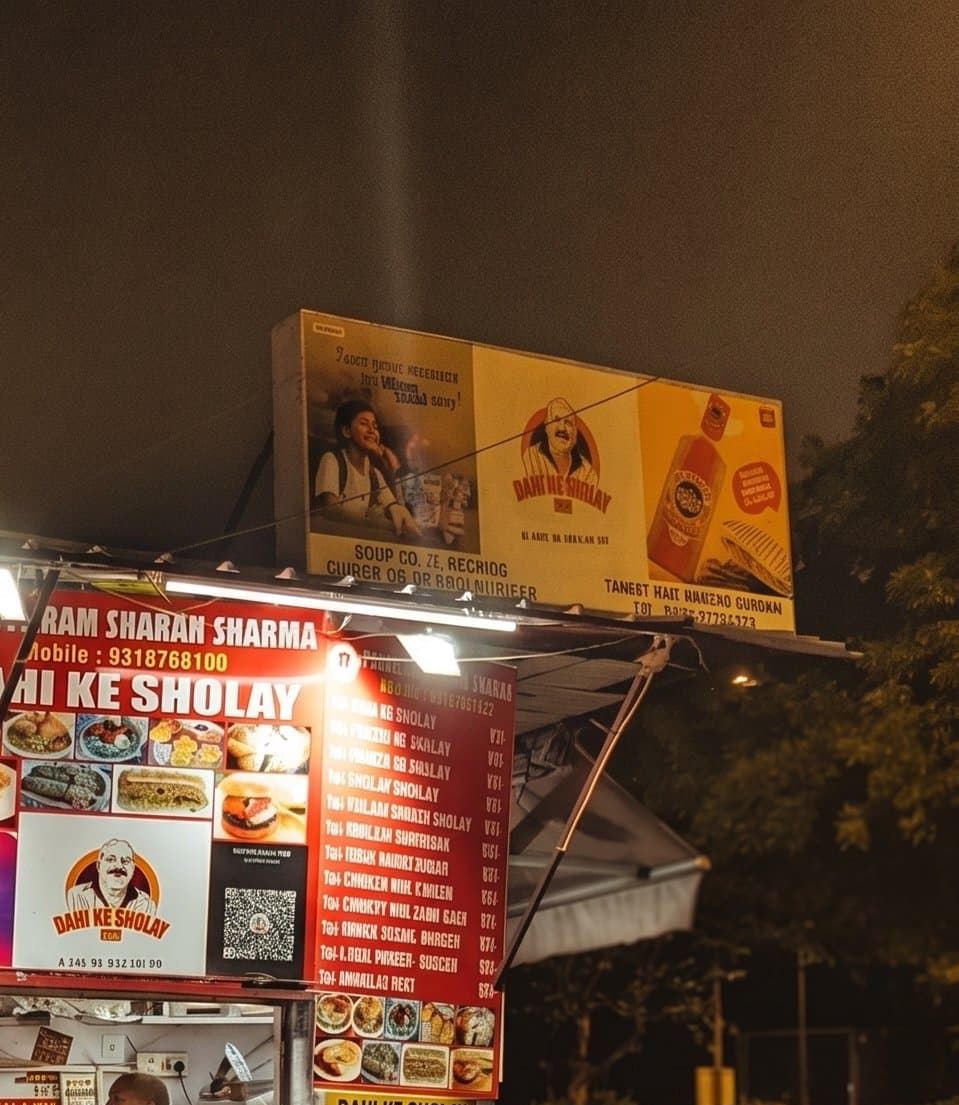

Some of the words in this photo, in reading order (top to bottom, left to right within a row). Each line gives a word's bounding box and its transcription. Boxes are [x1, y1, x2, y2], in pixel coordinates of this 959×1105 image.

[354, 544, 393, 564] SOUP
[106, 609, 205, 645] SHARAN
[212, 616, 318, 650] SHARMA
[109, 649, 228, 673] 9318768100
[67, 671, 121, 710] KE
[131, 675, 302, 721] SHOLAY
[52, 909, 90, 935] DAHI
[93, 908, 112, 927] KE
[114, 908, 171, 940] SHOLAY
